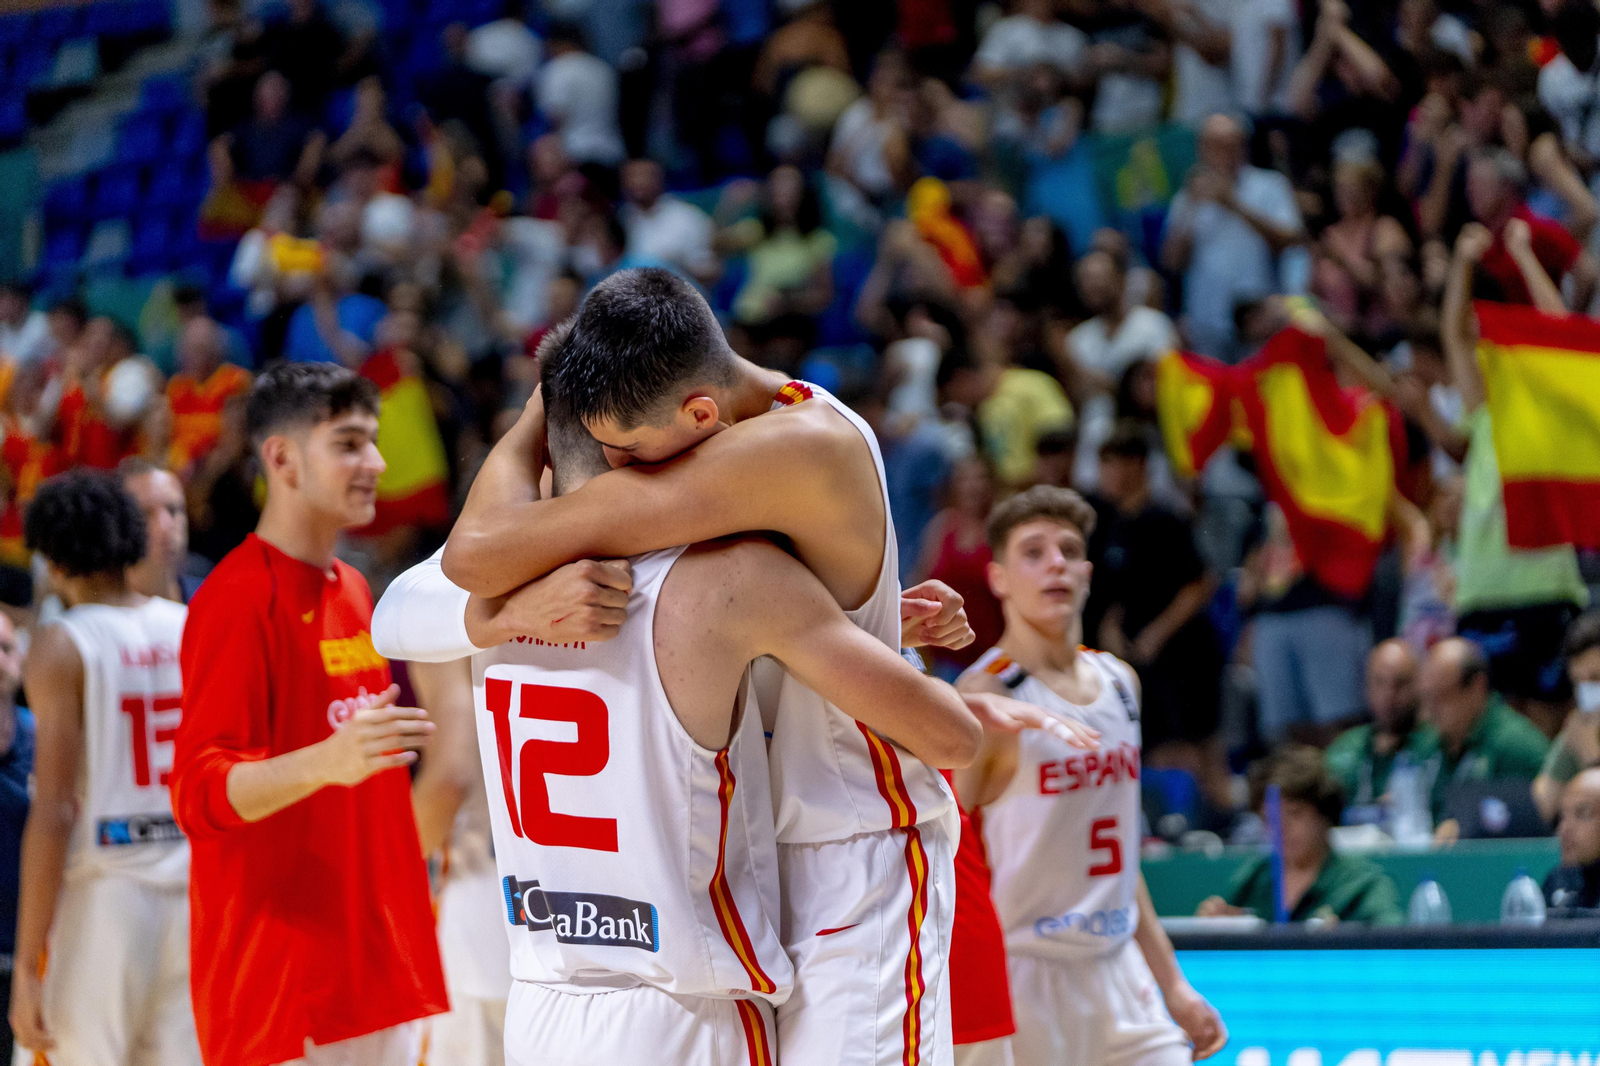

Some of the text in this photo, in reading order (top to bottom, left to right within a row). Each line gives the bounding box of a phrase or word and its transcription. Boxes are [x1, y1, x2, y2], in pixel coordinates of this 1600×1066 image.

[486, 677, 619, 853] 12
[1039, 741, 1141, 796] ESPAÑ
[1088, 816, 1124, 877] 5
[523, 886, 653, 945] CaBank
